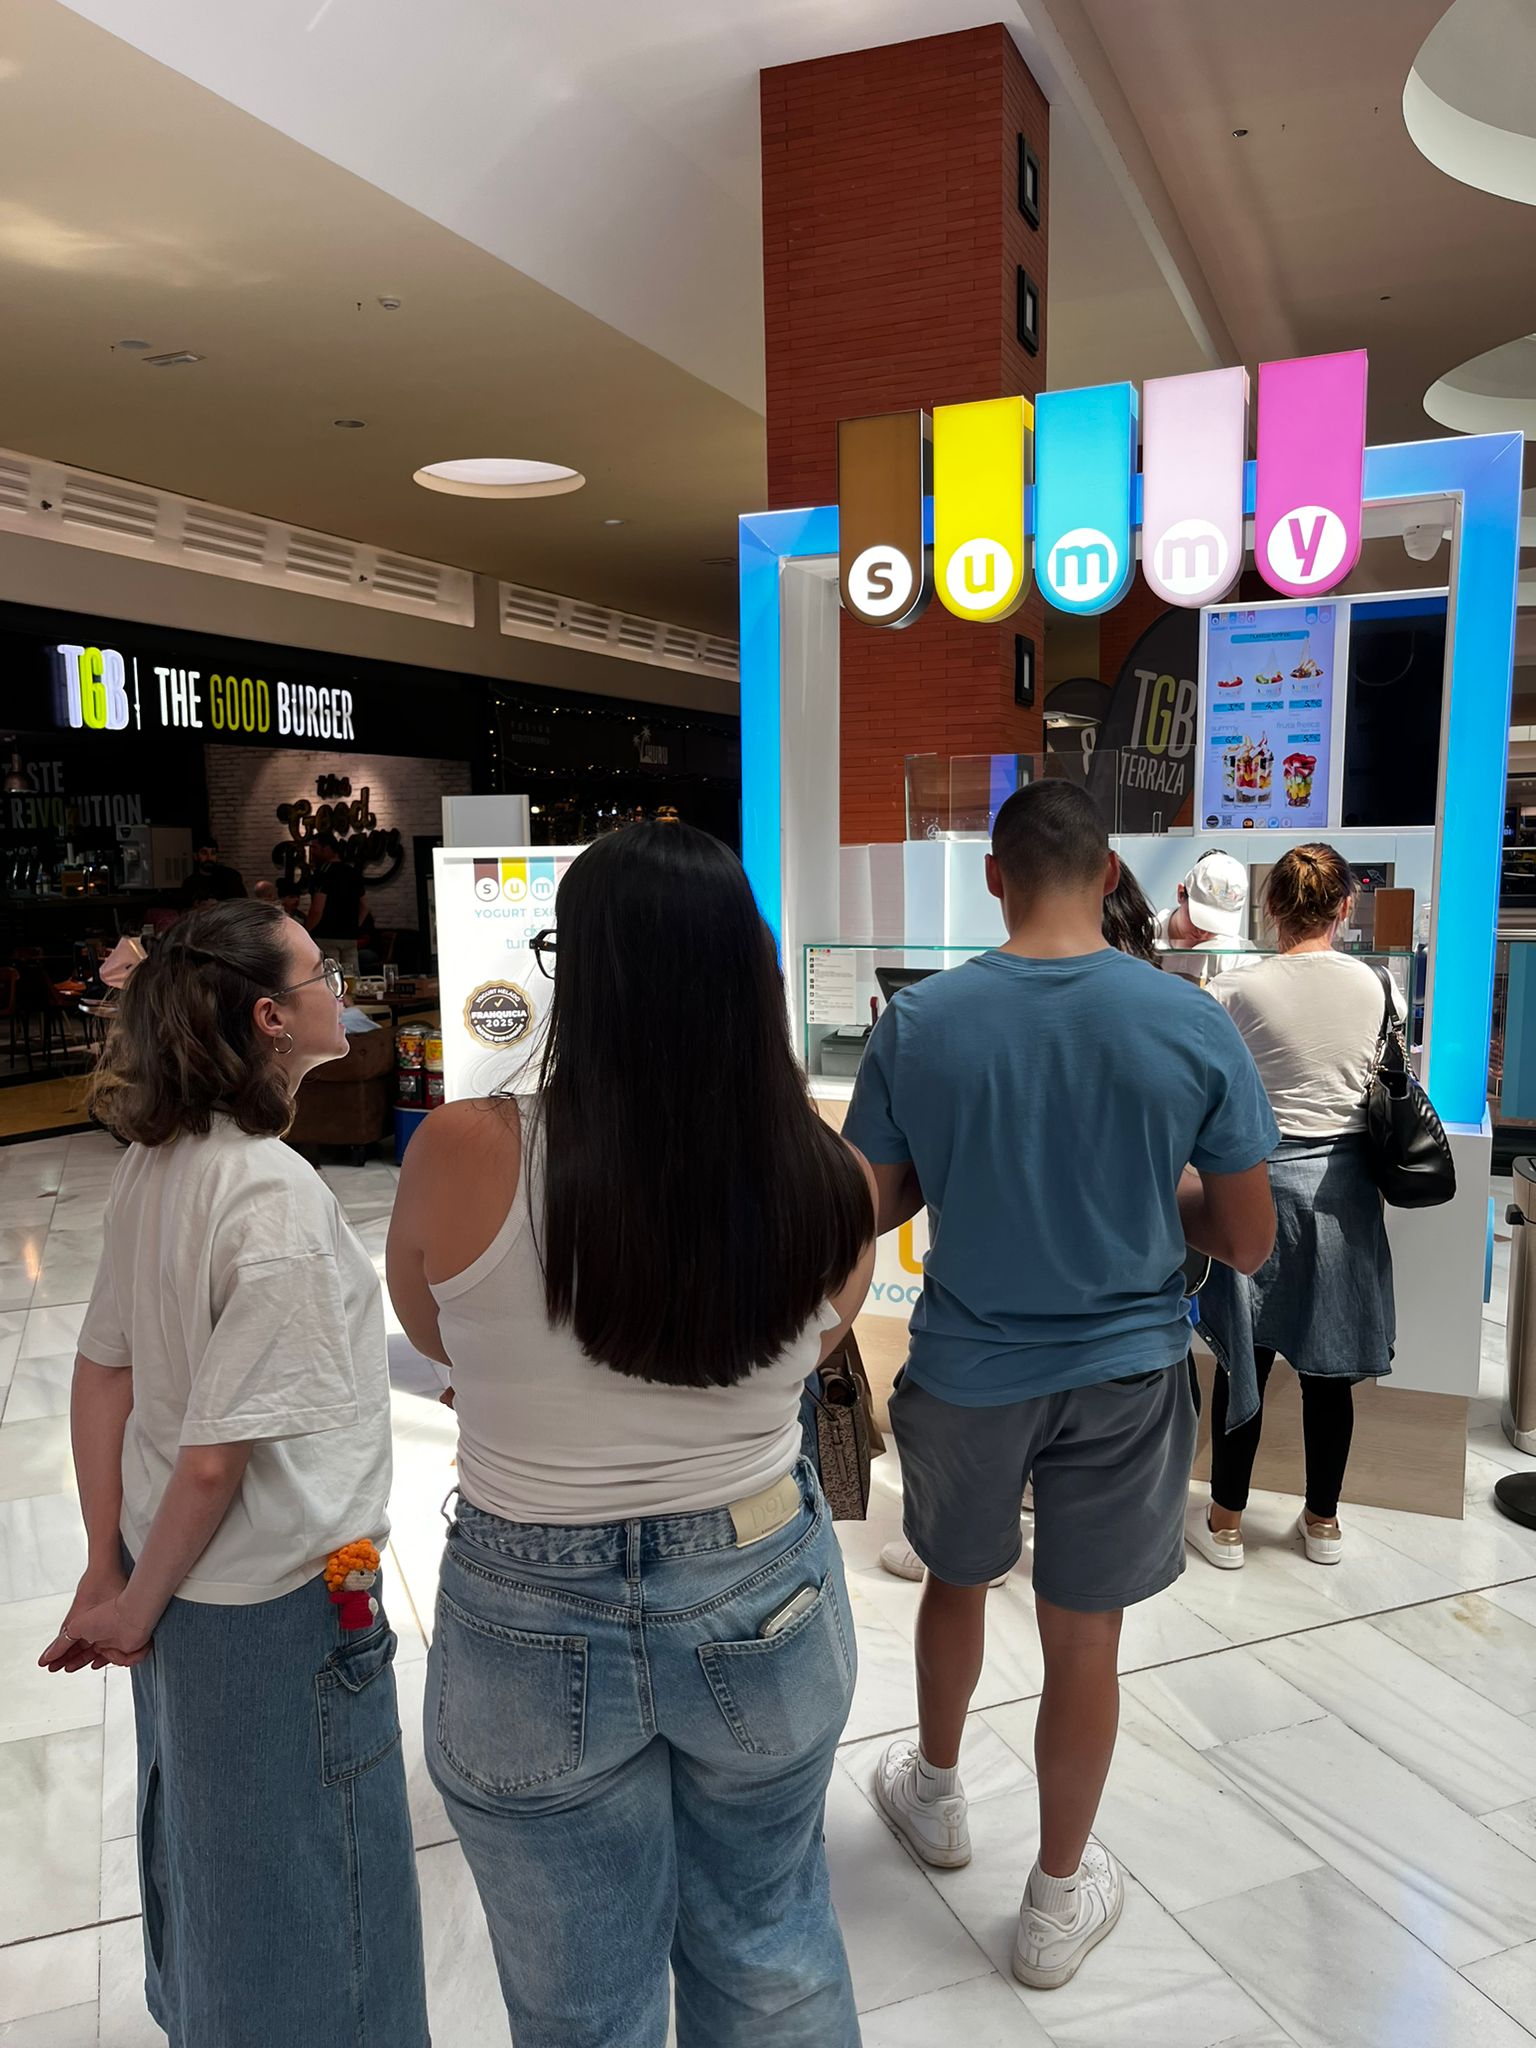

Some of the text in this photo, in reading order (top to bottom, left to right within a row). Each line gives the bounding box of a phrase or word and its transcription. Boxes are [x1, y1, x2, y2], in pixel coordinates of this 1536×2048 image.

[57, 644, 354, 741] TGB THE GOOD BURGER
[1130, 668, 1197, 759] TGB
[1119, 752, 1185, 796] TERRAZA
[475, 908, 527, 919] YOGURT
[471, 1009, 527, 1020] FRANQUICIA
[486, 1018, 514, 1028] 2025
